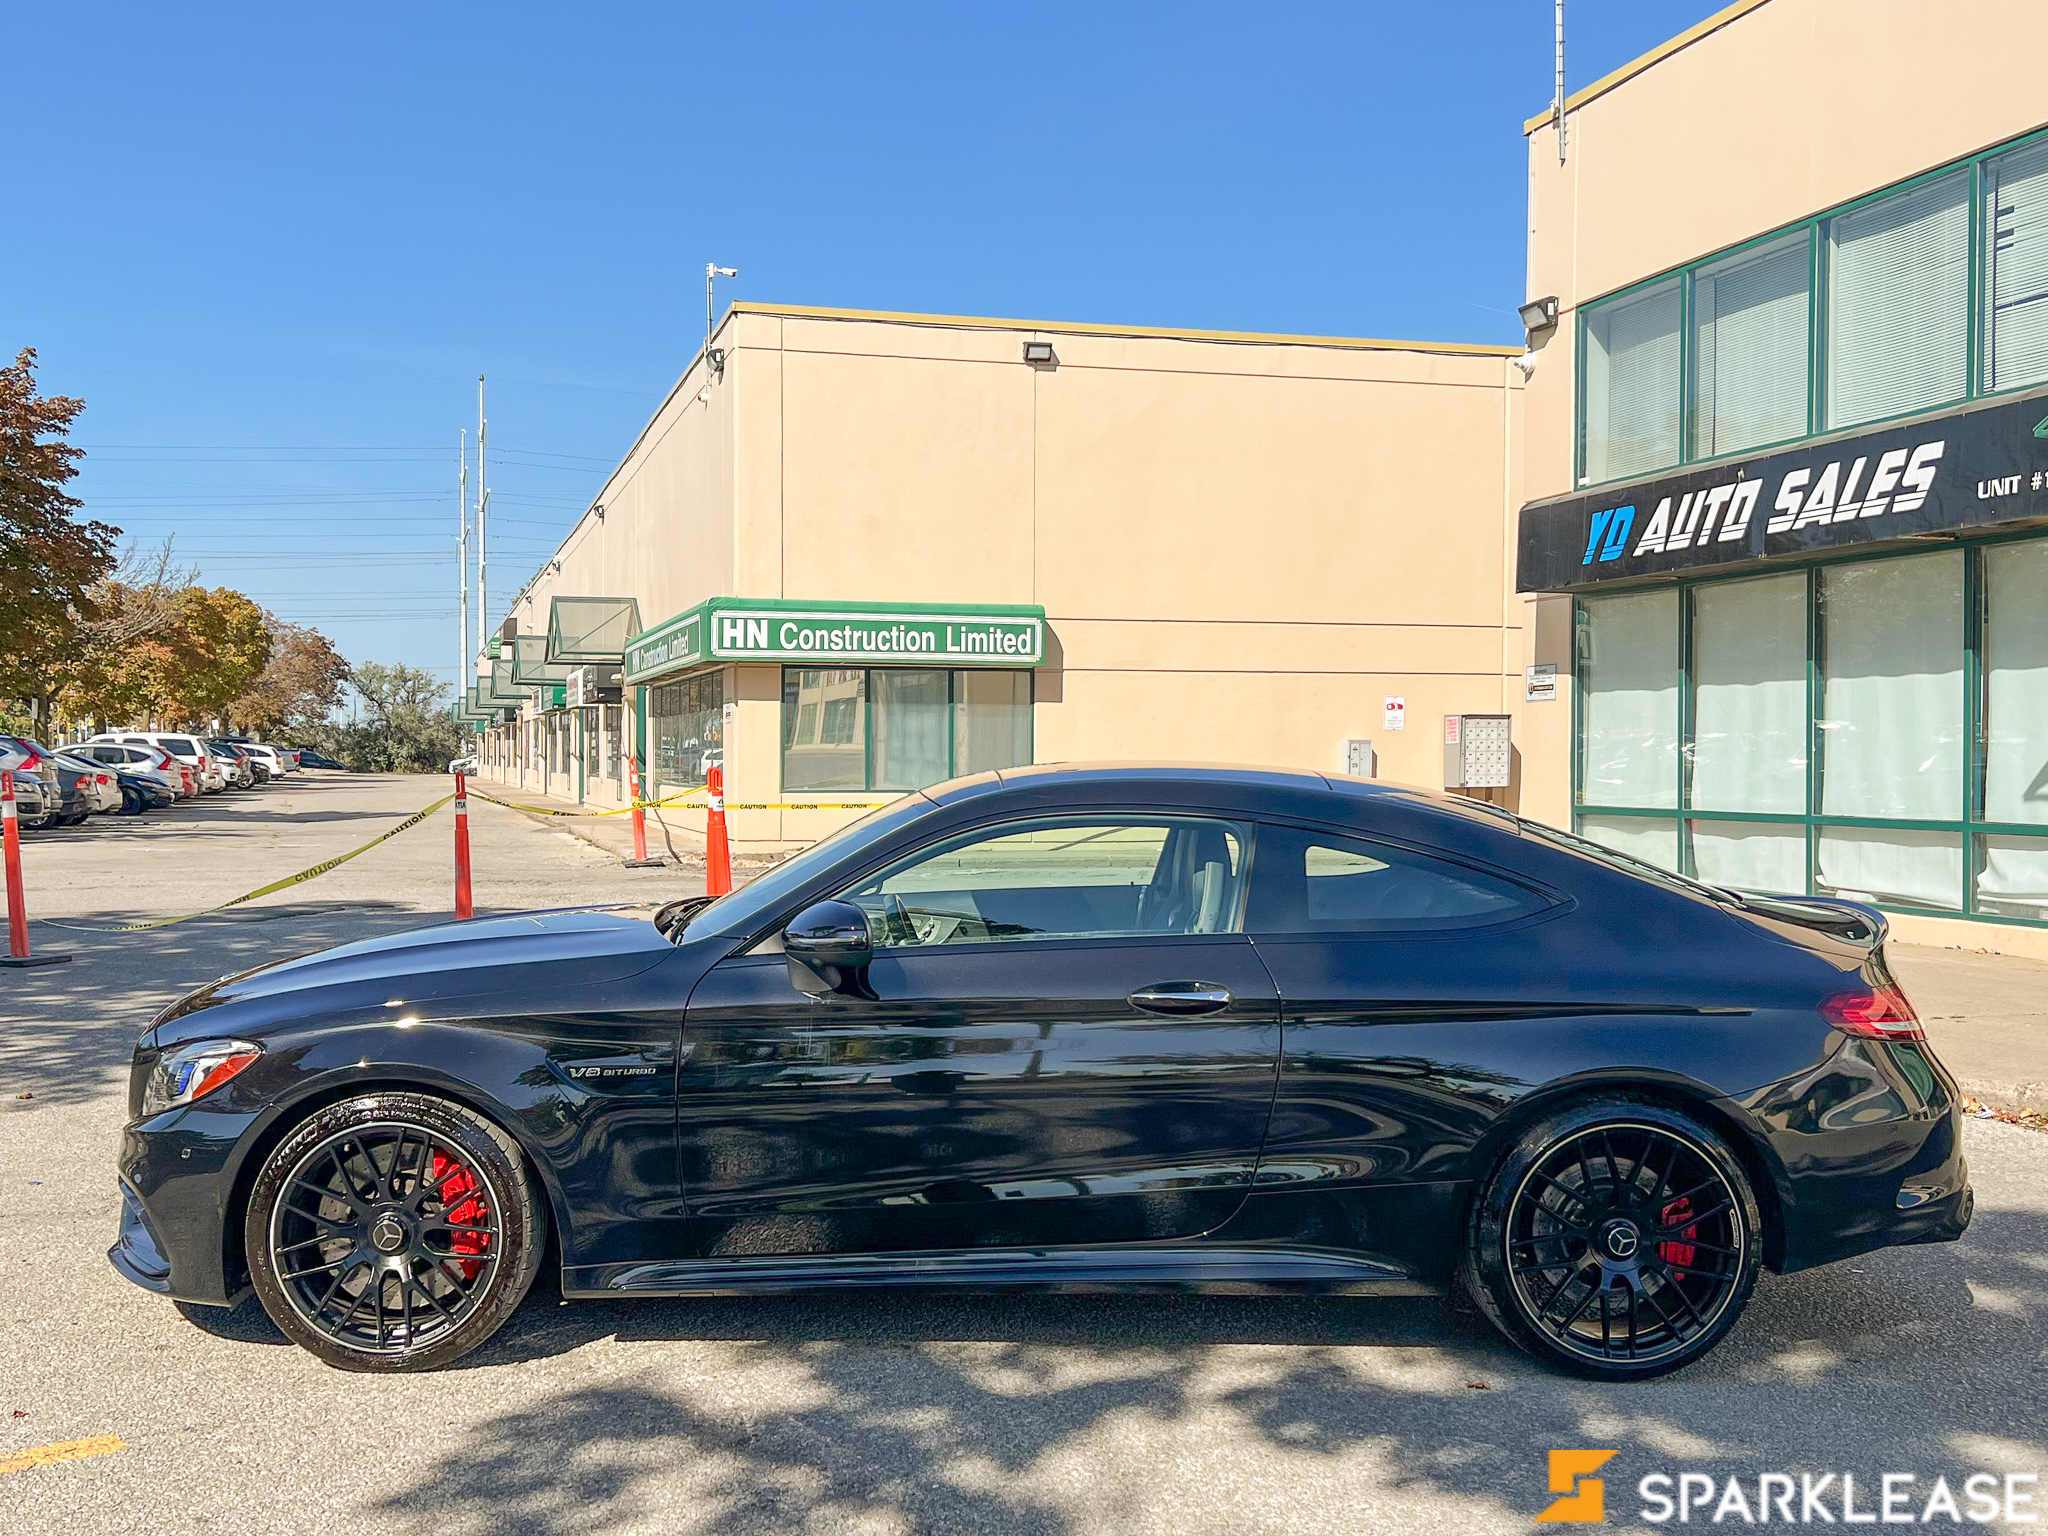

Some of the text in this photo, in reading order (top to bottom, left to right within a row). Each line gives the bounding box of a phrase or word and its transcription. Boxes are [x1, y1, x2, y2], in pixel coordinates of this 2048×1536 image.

[1633, 477, 1764, 558] AUTO
[1766, 440, 1945, 534] SALES
[1977, 474, 2022, 500] UNIT
[723, 618, 1031, 655] HN Construction Limited
[570, 1067, 656, 1078] V8 BITURBO
